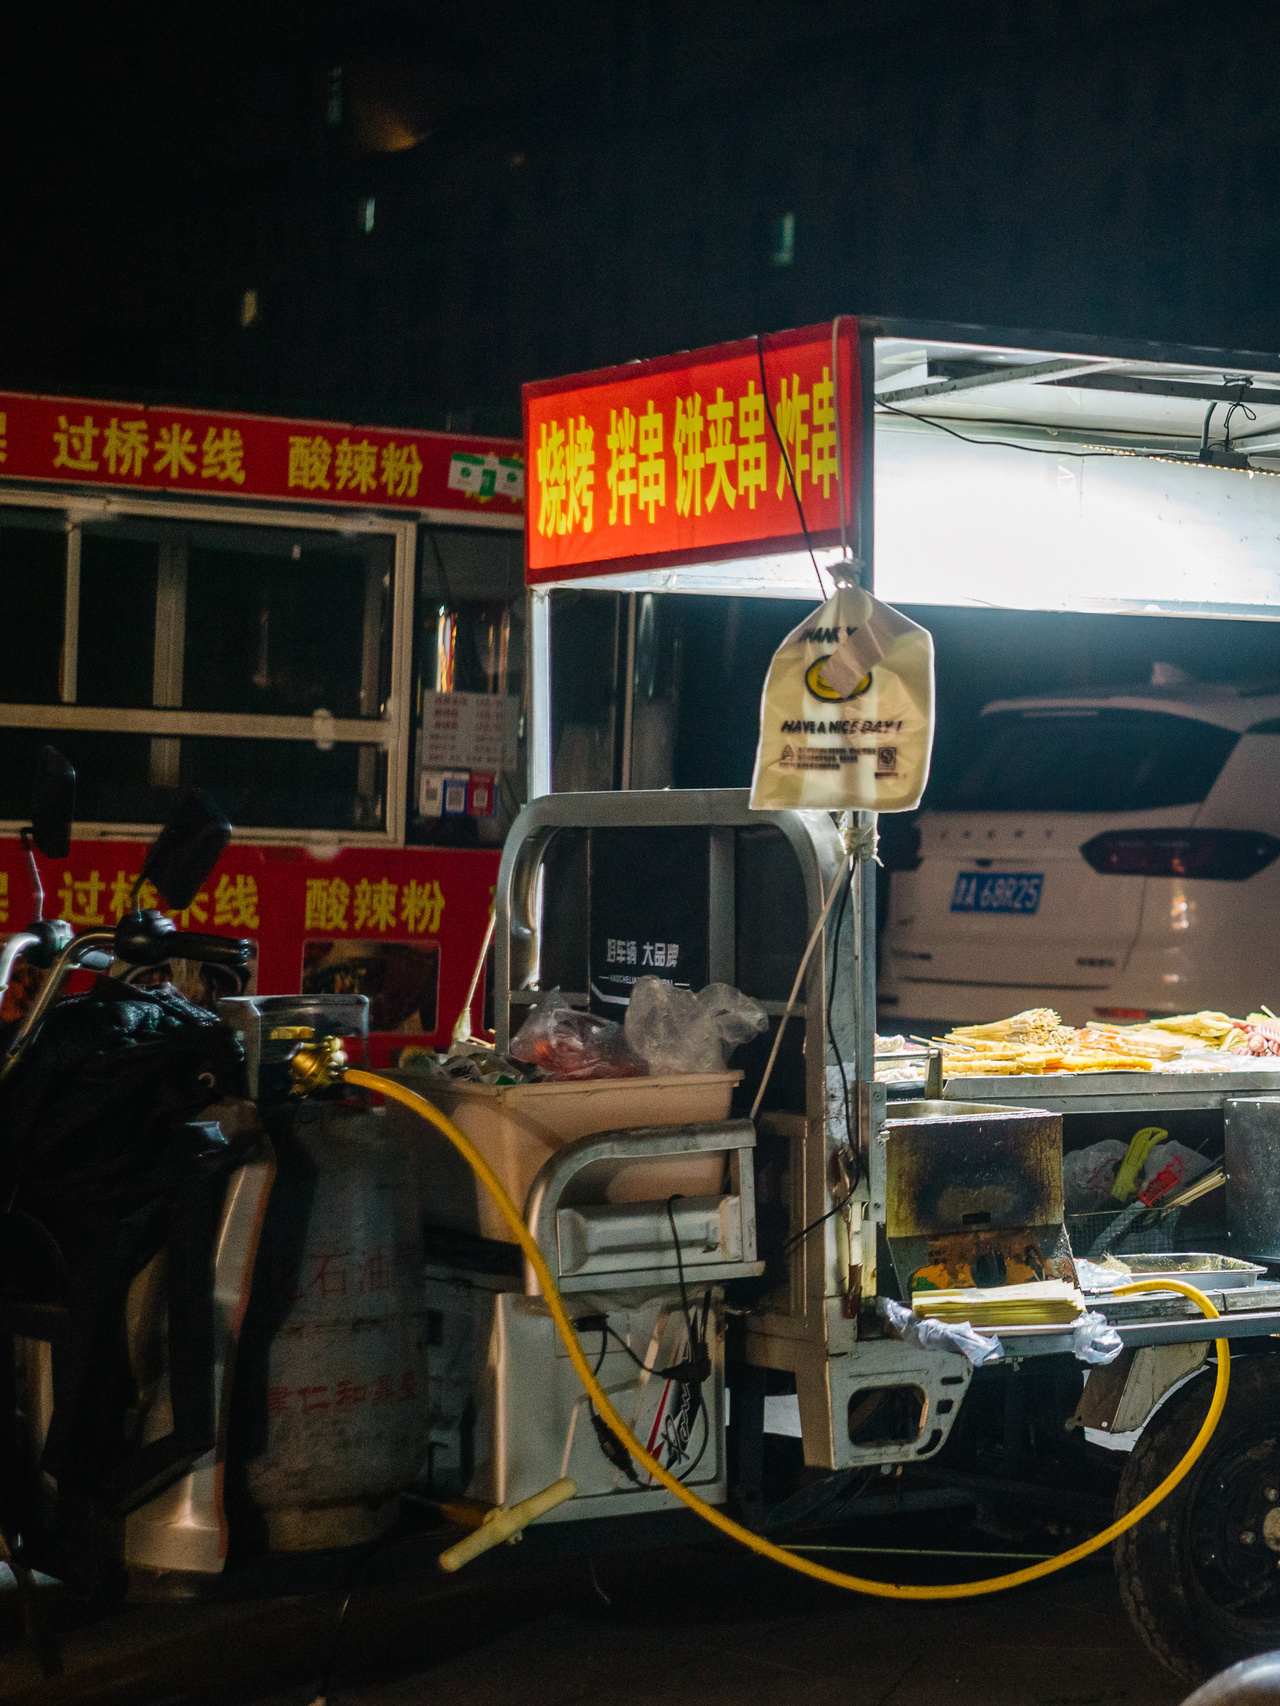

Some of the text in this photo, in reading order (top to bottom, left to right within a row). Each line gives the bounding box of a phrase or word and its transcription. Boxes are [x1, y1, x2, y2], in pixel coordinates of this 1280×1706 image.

[53, 414, 247, 485] 过桥米线
[287, 434, 424, 498] 酸辣粉
[537, 415, 595, 539] 烧烤
[607, 399, 666, 526] 拌串
[673, 380, 767, 518] 饼夹串
[776, 366, 840, 501] 炸串
[781, 720, 816, 735] HAVE
[816, 721, 827, 735] A
[828, 720, 858, 735] NICE
[304, 878, 446, 933] 酸辣粉
[642, 941, 680, 968] 大品牌
